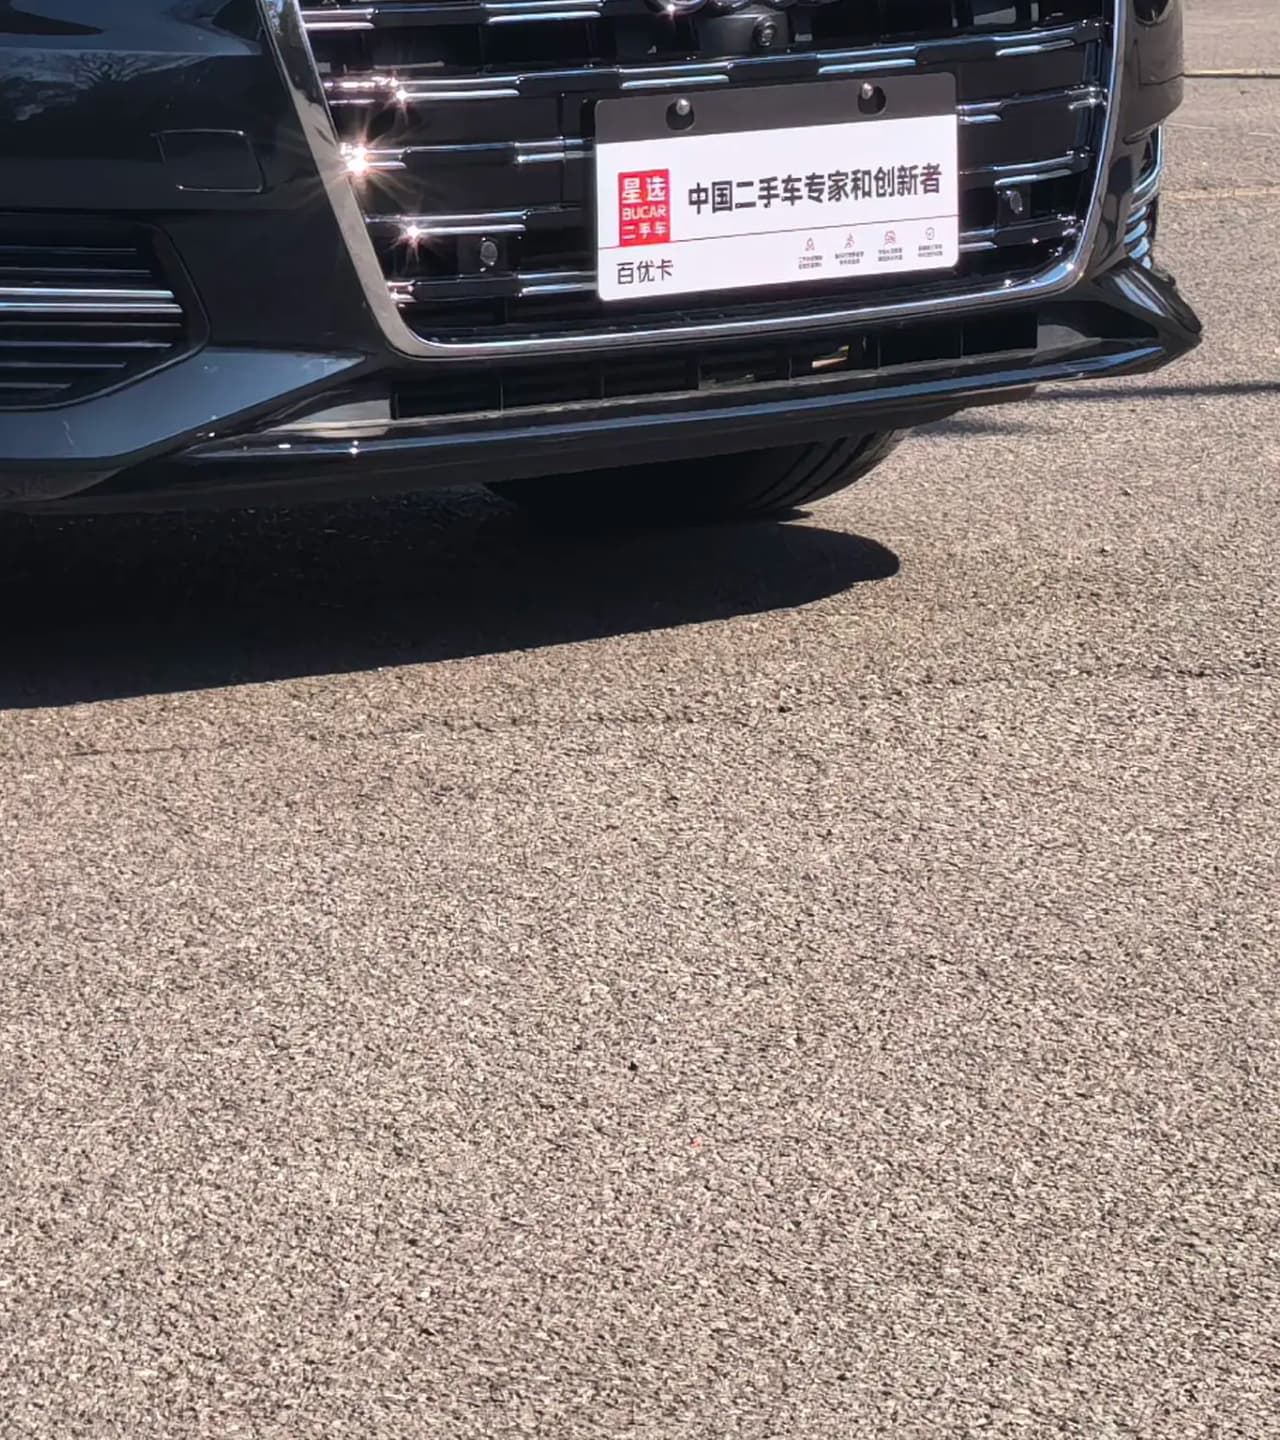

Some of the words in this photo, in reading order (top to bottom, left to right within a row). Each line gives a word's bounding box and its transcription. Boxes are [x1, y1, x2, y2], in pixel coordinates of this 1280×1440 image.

[622, 176, 666, 204] 星选
[688, 163, 942, 214] 中国二手车专家和创新者
[623, 205, 667, 221] BUCAR
[623, 221, 667, 240] 二手车
[616, 259, 674, 285] 百优卡
